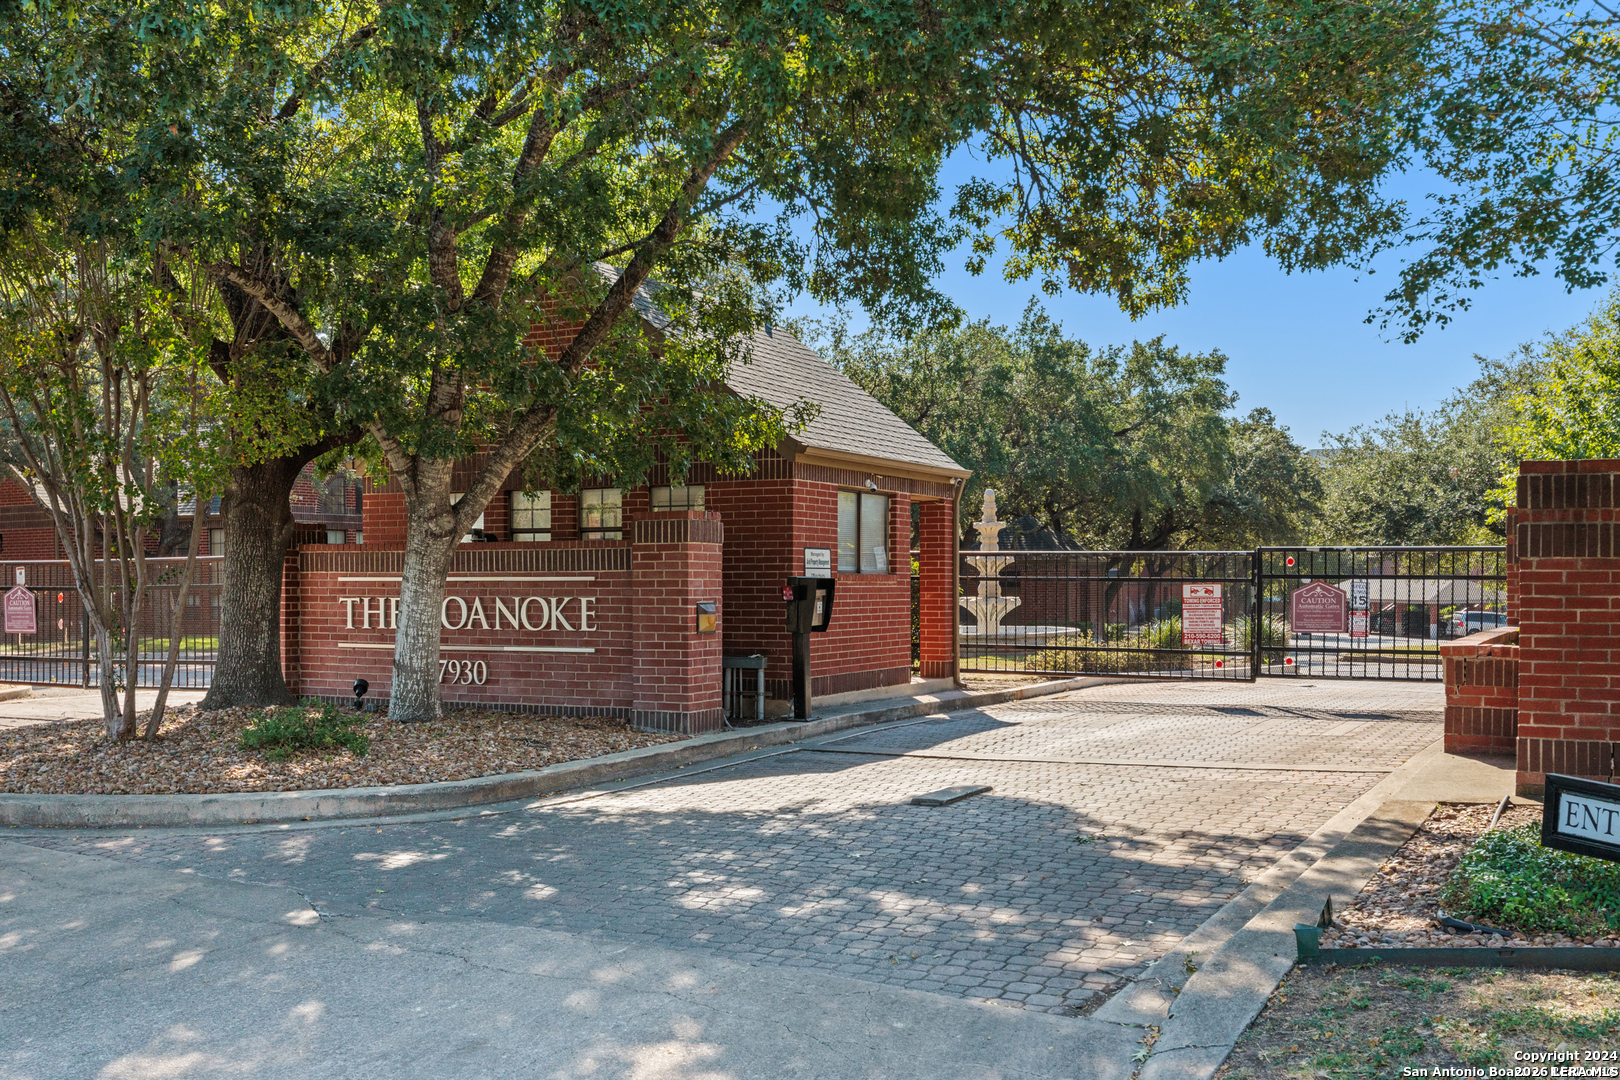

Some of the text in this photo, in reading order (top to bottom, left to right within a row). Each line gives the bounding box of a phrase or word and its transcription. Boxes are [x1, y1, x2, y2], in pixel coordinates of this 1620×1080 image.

[440, 596, 598, 632] OANOKE
[439, 660, 487, 685] 7930
[1565, 800, 1620, 836] ENT
